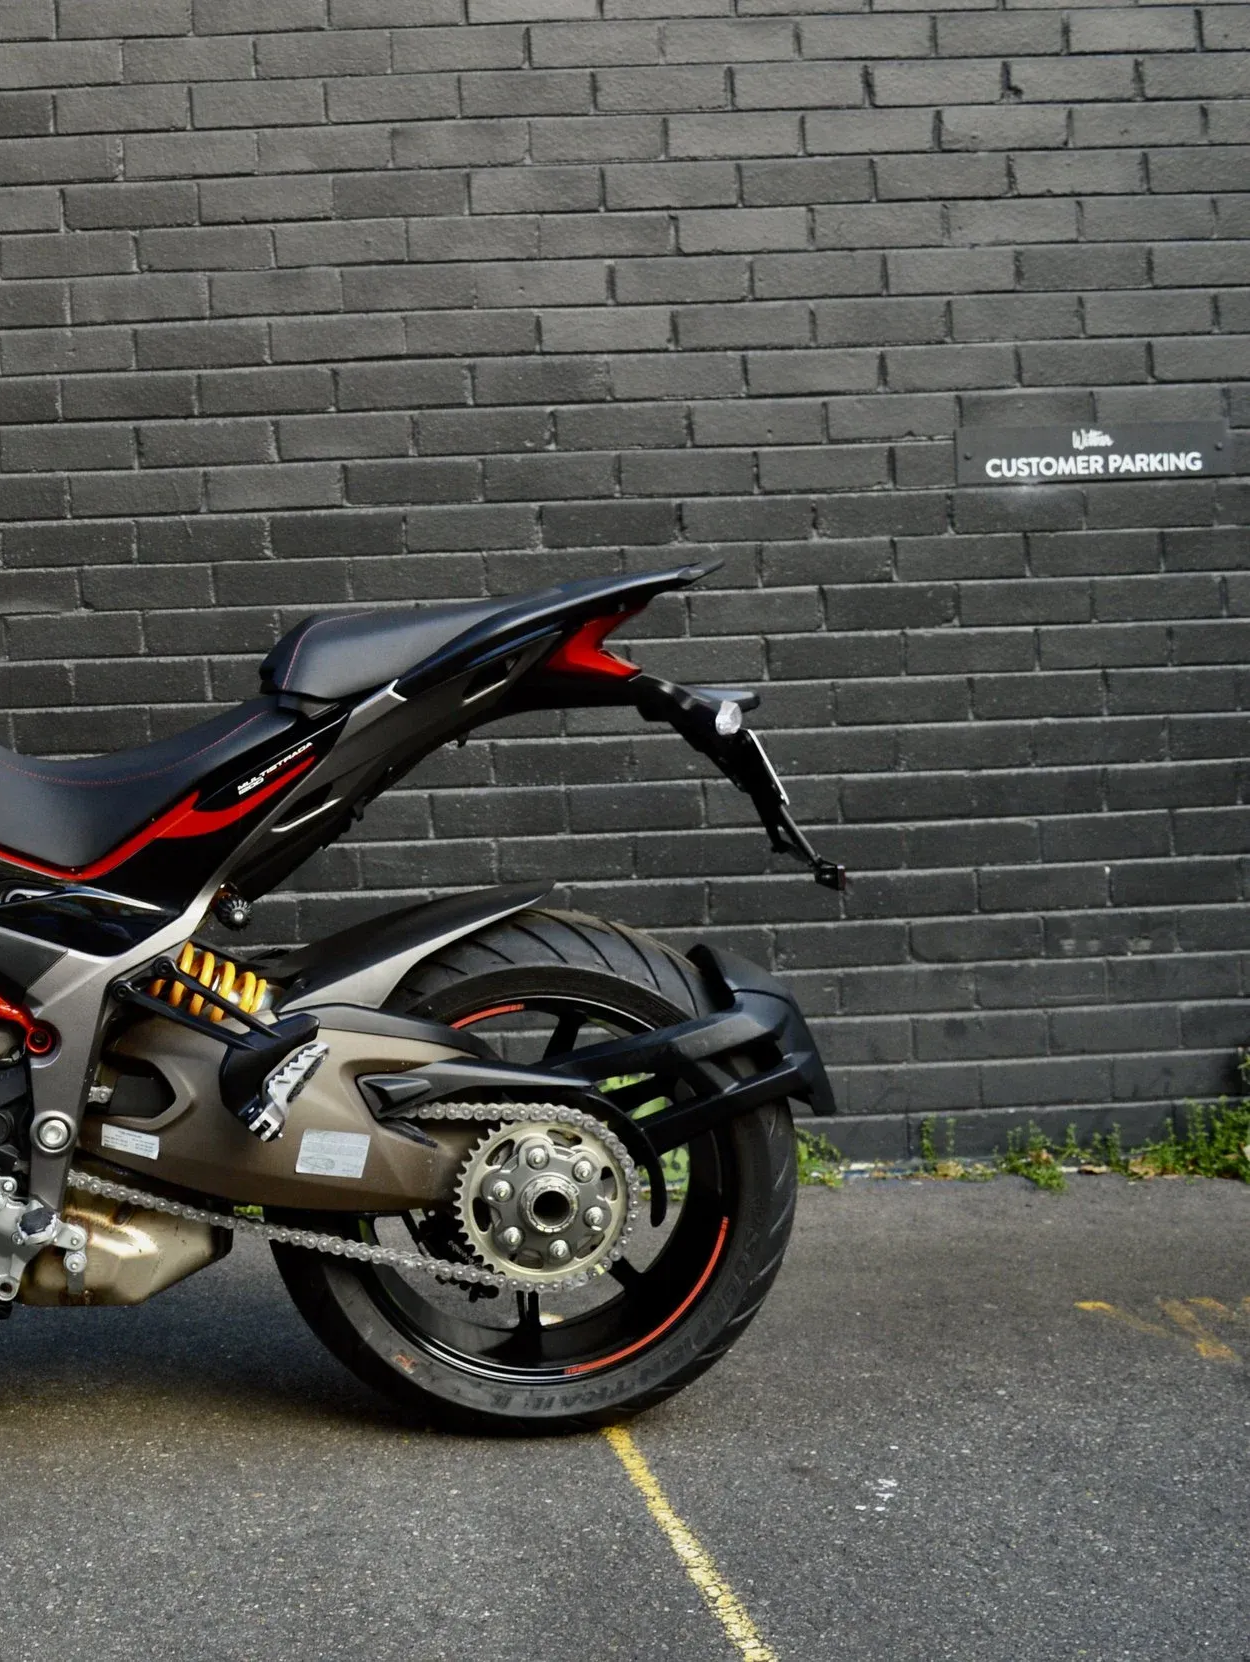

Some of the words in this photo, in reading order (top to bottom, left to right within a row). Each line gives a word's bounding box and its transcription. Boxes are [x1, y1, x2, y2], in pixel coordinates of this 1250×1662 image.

[985, 455, 1104, 478] CUSTOMER
[1108, 451, 1203, 473] PARKING
[237, 741, 313, 791] MULTISTRADA
